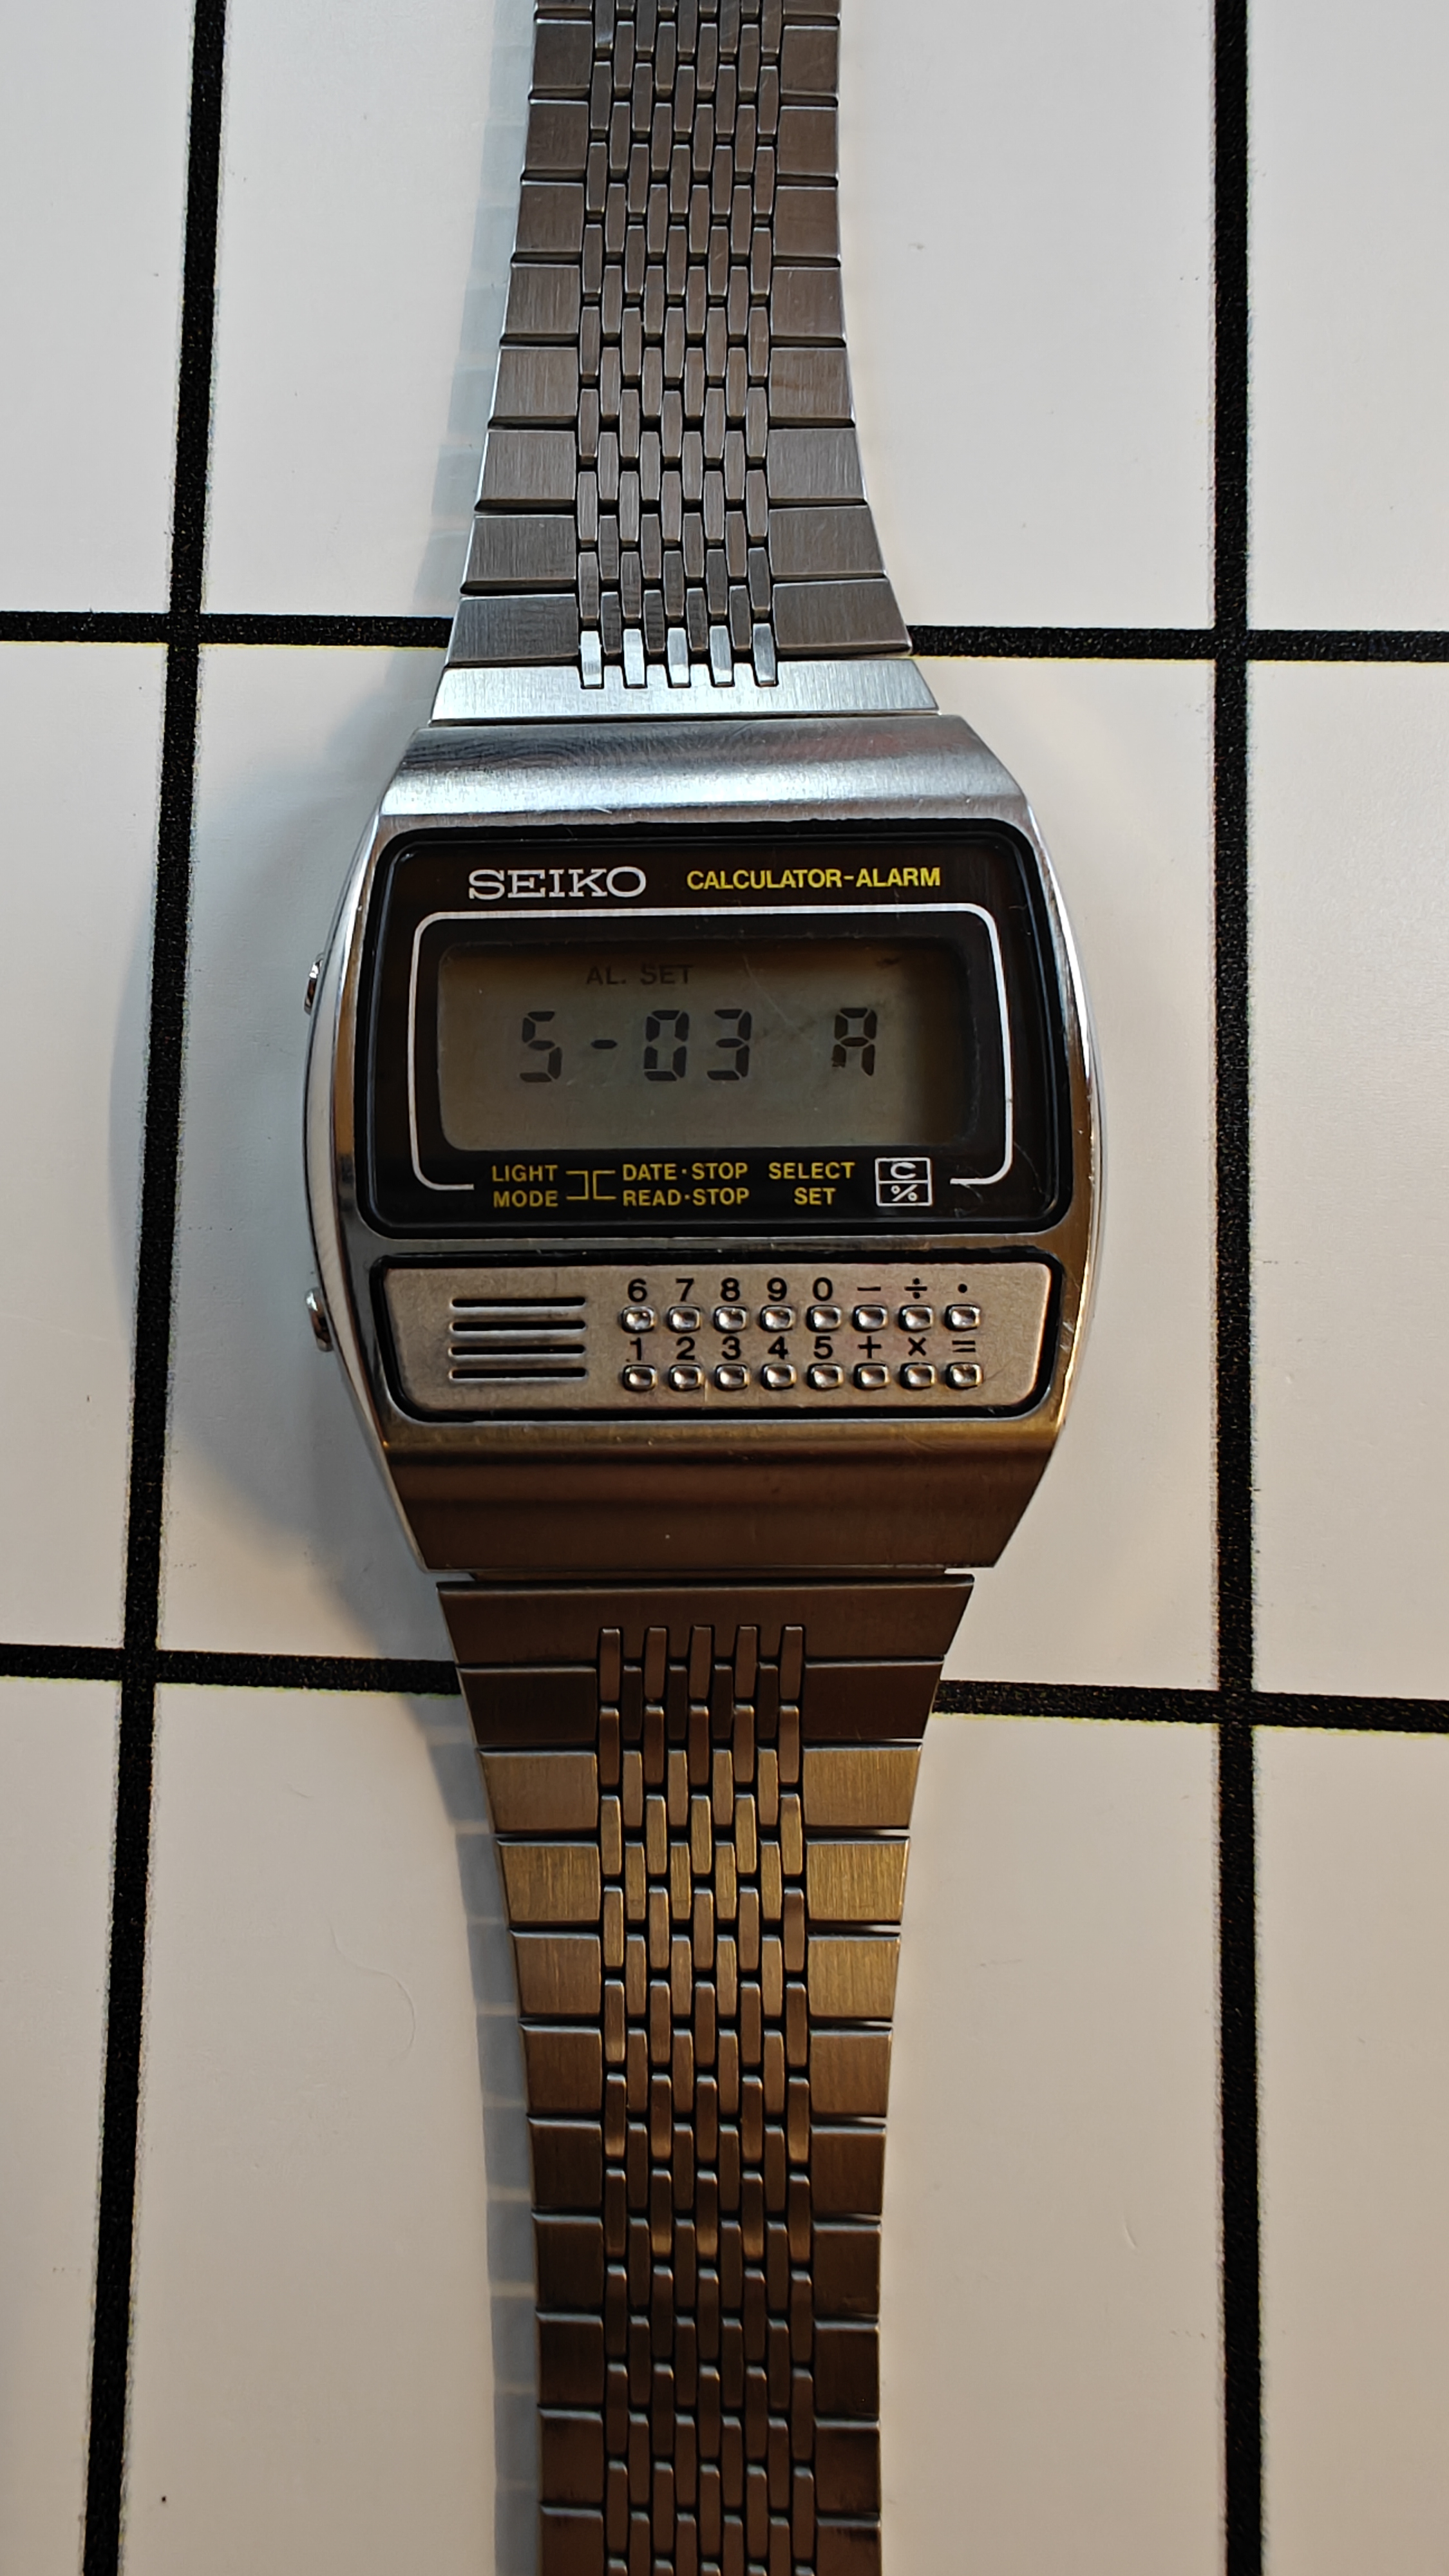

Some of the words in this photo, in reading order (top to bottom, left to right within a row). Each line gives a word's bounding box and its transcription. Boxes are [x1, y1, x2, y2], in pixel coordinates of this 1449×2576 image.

[468, 867, 646, 900] SEIKO
[687, 867, 941, 890] CALCULATOR-ALARM
[587, 965, 627, 986] AL.
[639, 965, 693, 986] SET
[491, 1164, 558, 1182] LIGHT
[768, 1162, 855, 1180] SELECT
[890, 1163, 916, 1179] C
[493, 1190, 558, 1209] MODE
[793, 1188, 836, 1206] SET
[627, 1278, 647, 1302] 6
[675, 1278, 695, 1302] 7
[720, 1278, 741, 1302] 8
[767, 1278, 787, 1302] 9
[812, 1277, 833, 1302] 0
[629, 1338, 644, 1361] 1
[676, 1337, 696, 1361] 2
[721, 1336, 741, 1361] 3
[768, 1336, 789, 1360] 4
[813, 1336, 833, 1359] 5
